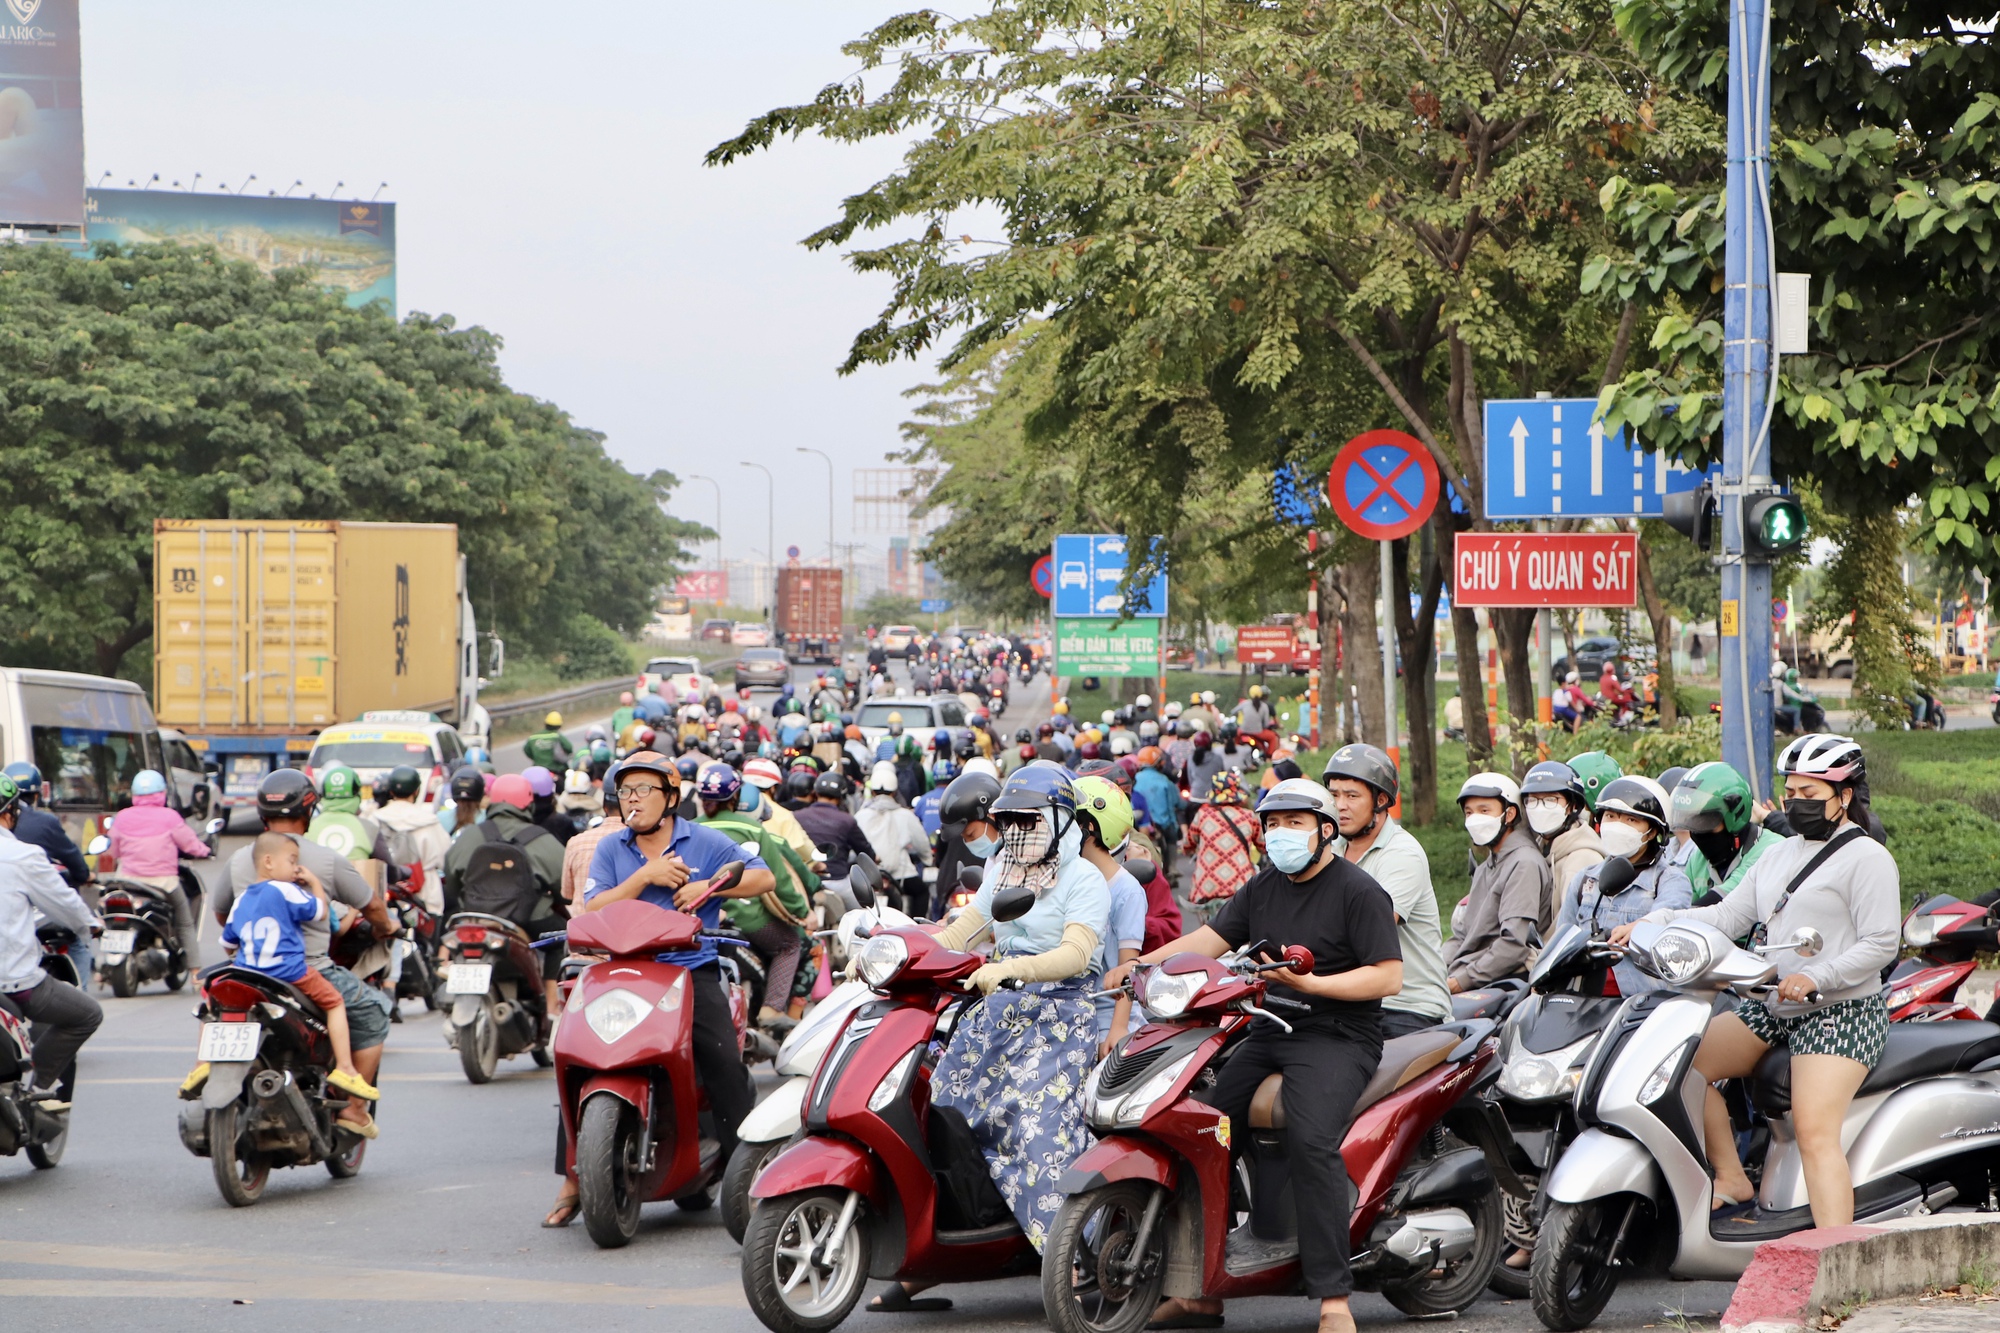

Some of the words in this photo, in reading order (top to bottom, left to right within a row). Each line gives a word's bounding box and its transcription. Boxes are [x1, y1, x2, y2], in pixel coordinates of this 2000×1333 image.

[1460, 540, 1501, 590] CHÚ
[1507, 540, 1522, 590] Ý
[1528, 550, 1584, 591] QUAN
[1592, 540, 1632, 590] SÁT
[1723, 611, 1732, 624] 26
[1129, 637, 1154, 653] VETC
[239, 915, 284, 969] 12
[608, 967, 643, 976] HONDA
[211, 1025, 251, 1041] 54-X5
[209, 1043, 249, 1058] 1027
[1438, 1064, 1476, 1094] VISION
